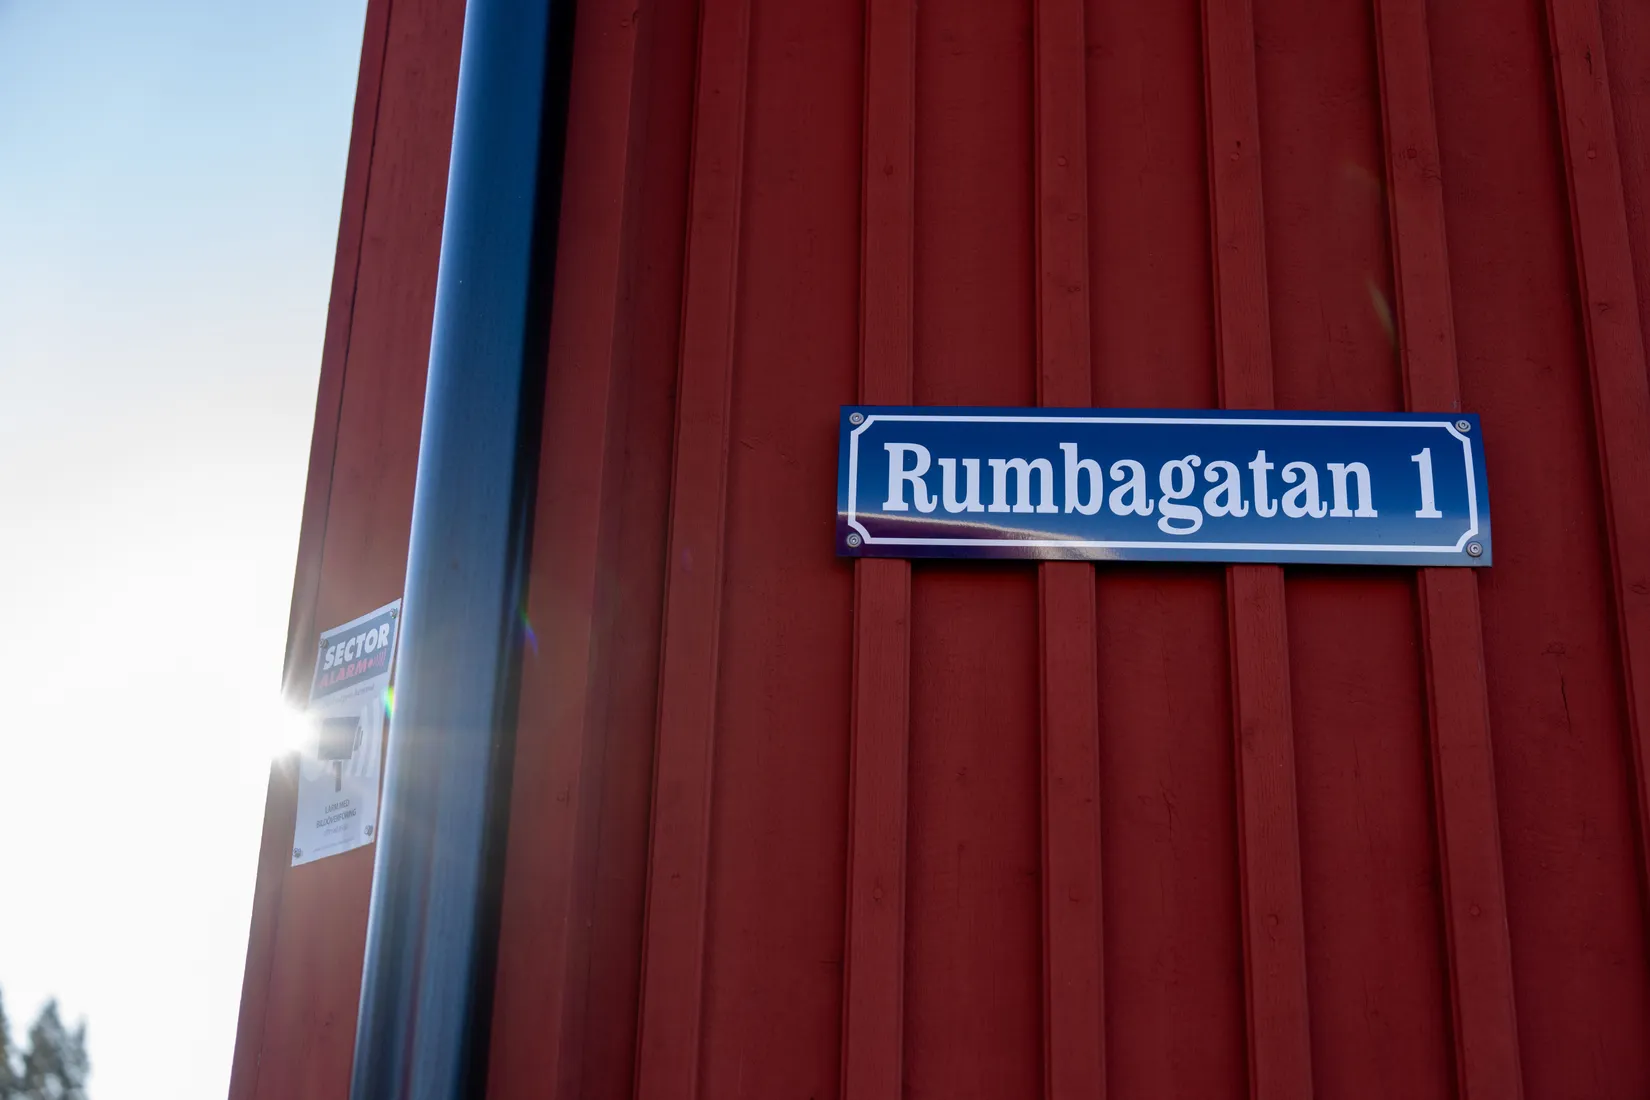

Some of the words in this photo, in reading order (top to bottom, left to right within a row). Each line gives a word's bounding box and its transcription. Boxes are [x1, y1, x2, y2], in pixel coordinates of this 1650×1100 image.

[882, 442, 1378, 535] Rumbagatan
[1411, 447, 1443, 519] 1
[323, 623, 390, 670] SECTOR
[320, 658, 368, 687] ALARM
